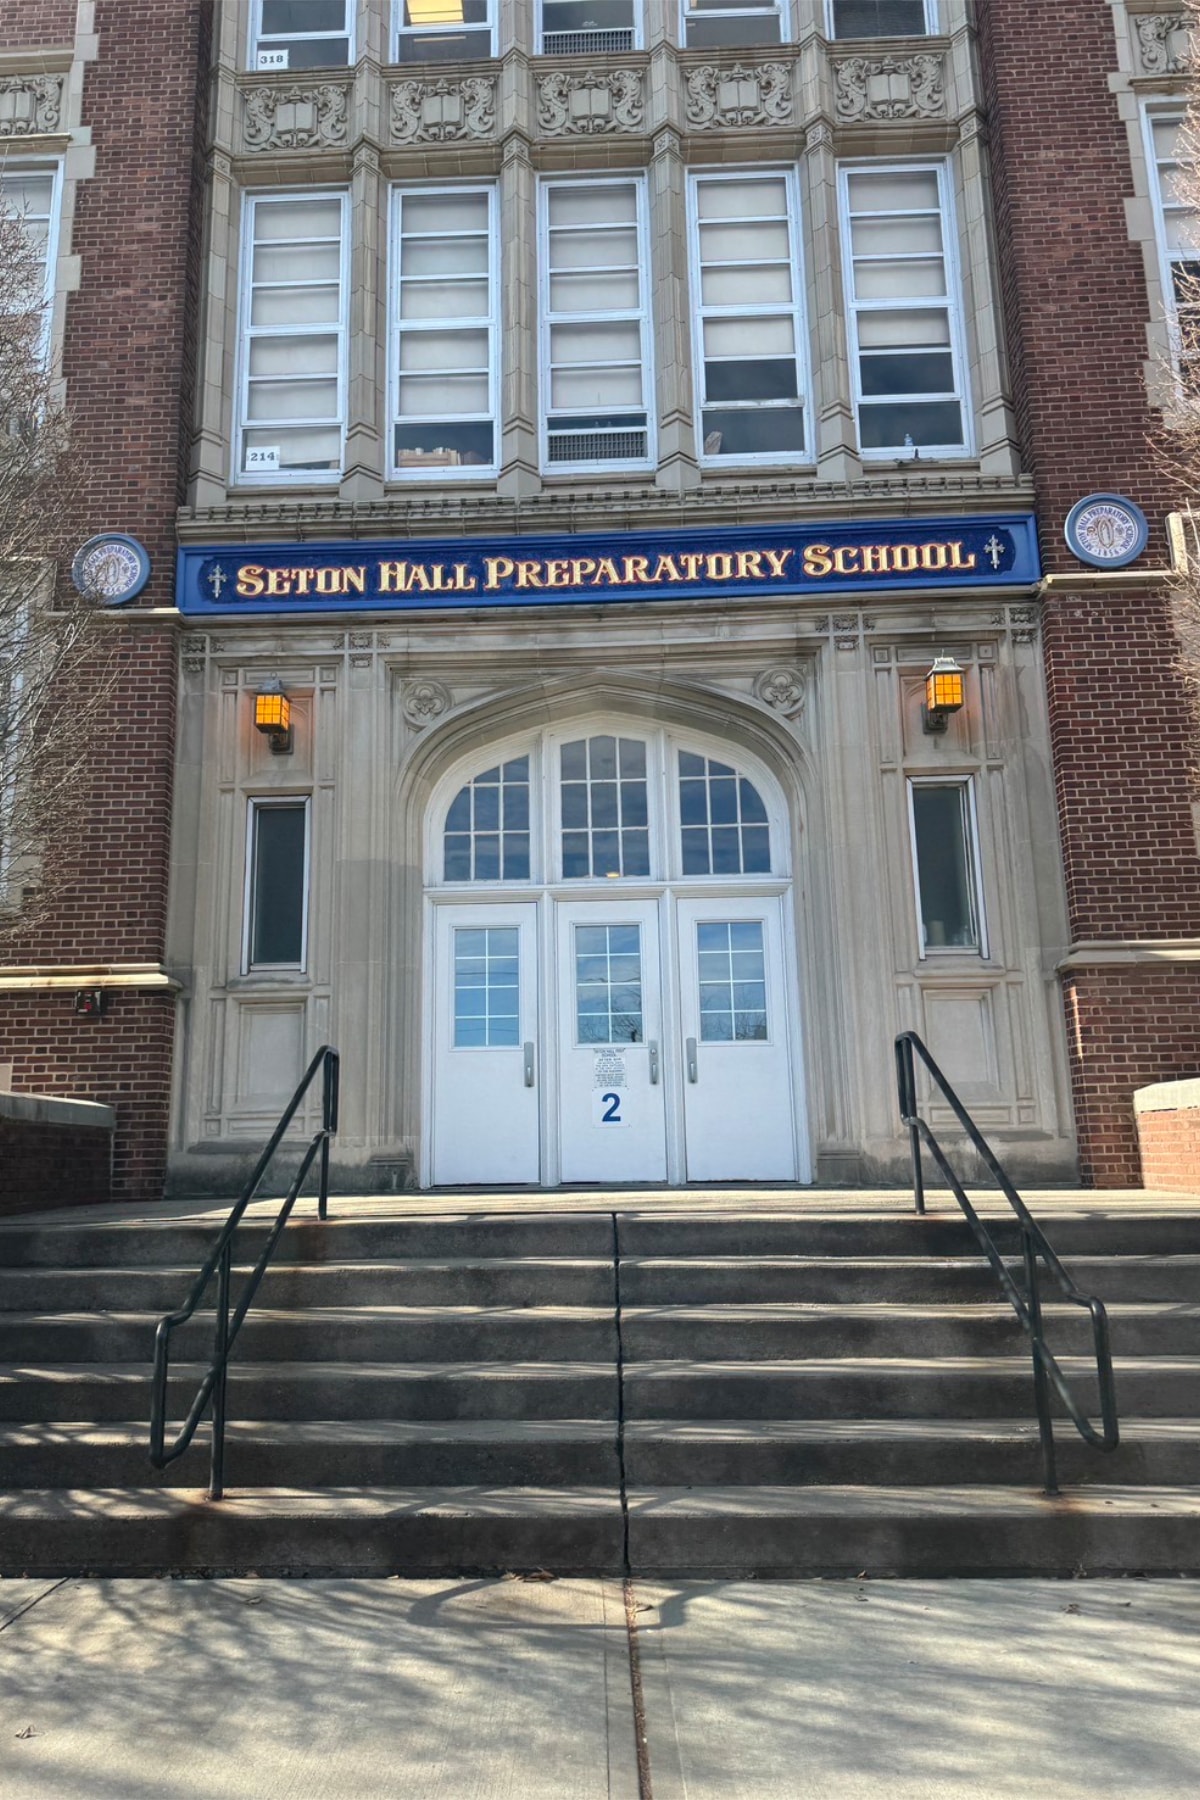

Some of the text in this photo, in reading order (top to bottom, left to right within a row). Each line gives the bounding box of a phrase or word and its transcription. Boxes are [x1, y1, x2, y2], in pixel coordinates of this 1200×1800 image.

[260, 55, 284, 64] 318
[250, 451, 275, 461] 214
[236, 541, 976, 596] SETON HALL PREPARATORY SCHOOL
[602, 1092, 621, 1122] 2
